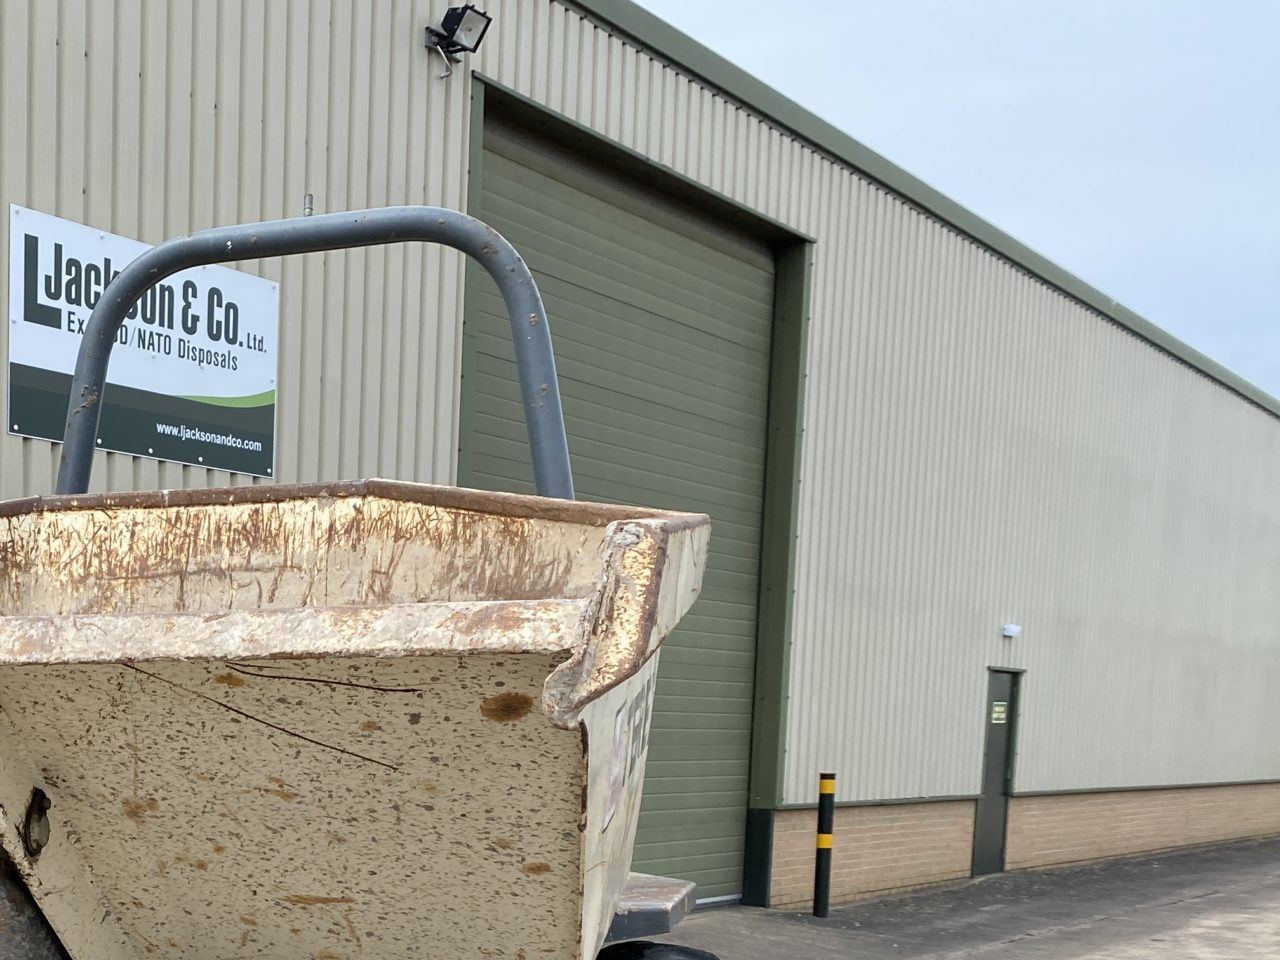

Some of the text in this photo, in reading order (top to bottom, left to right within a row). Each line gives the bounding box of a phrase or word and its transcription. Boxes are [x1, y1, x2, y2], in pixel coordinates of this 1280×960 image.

[44, 242, 175, 330] Jacon
[181, 279, 201, 336] &
[207, 286, 244, 347] Co.
[247, 332, 267, 353] Ltd.
[178, 337, 238, 371] Disposals
[156, 422, 262, 452] www.ljacksonandco.com
